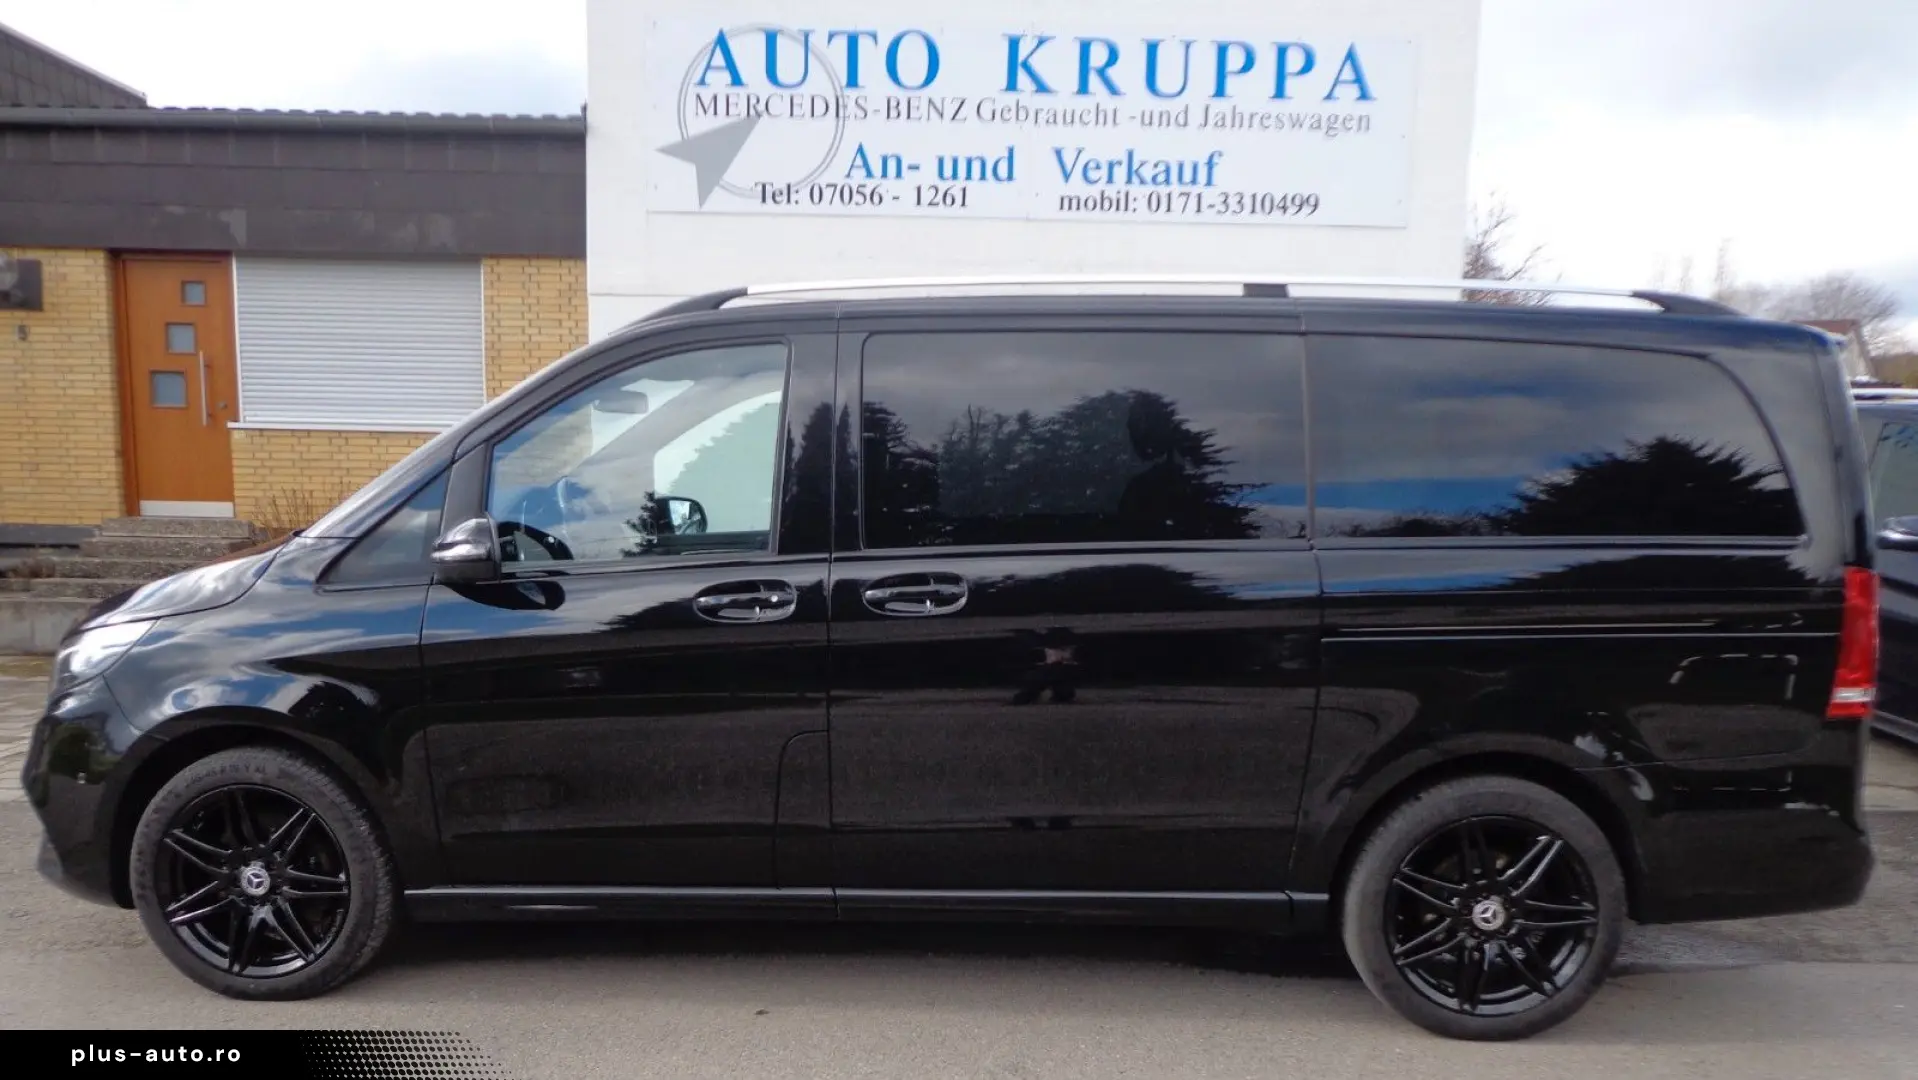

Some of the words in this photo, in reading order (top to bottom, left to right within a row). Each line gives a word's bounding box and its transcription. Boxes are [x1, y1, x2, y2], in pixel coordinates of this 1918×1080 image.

[693, 27, 941, 92] AUTO
[999, 33, 1379, 101] KRUPPA
[694, 92, 968, 122] MERCEDES-BENZ
[976, 97, 1120, 128] Gebraucht
[1199, 104, 1373, 138] Jahreswagen
[845, 142, 921, 181] An-
[935, 145, 1015, 182] und
[1052, 145, 1224, 188] Verkauf
[754, 182, 801, 206] Tel:
[808, 183, 883, 207] 07056
[914, 184, 970, 208] 1261
[1059, 190, 1139, 215] mobil:
[1146, 191, 1321, 217] 0171-3310499
